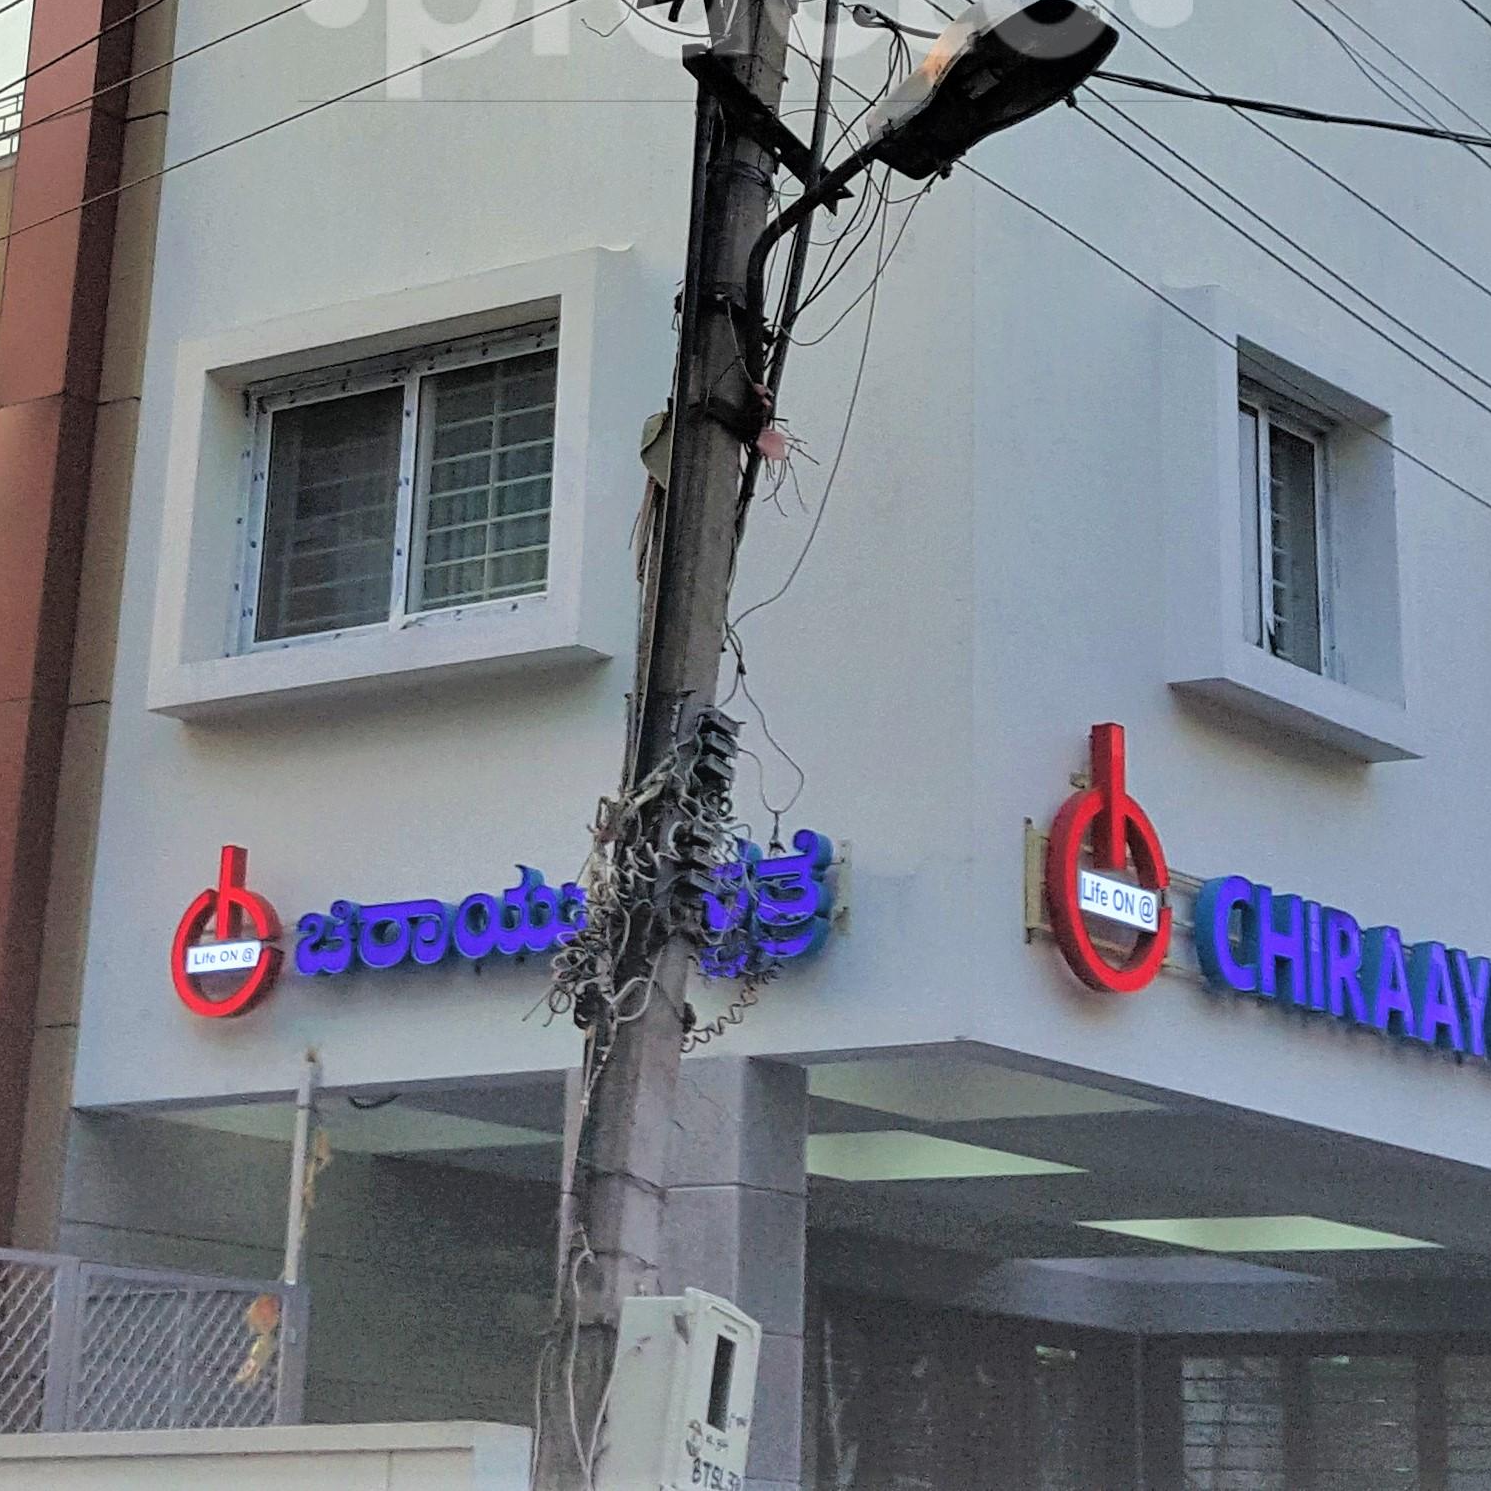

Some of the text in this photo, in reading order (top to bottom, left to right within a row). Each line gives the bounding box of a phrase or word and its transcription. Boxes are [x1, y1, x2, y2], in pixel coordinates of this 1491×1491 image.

[1081, 878, 1154, 924] Life ON @
[194, 951, 216, 965] Life
[219, 949, 239, 963] ON
